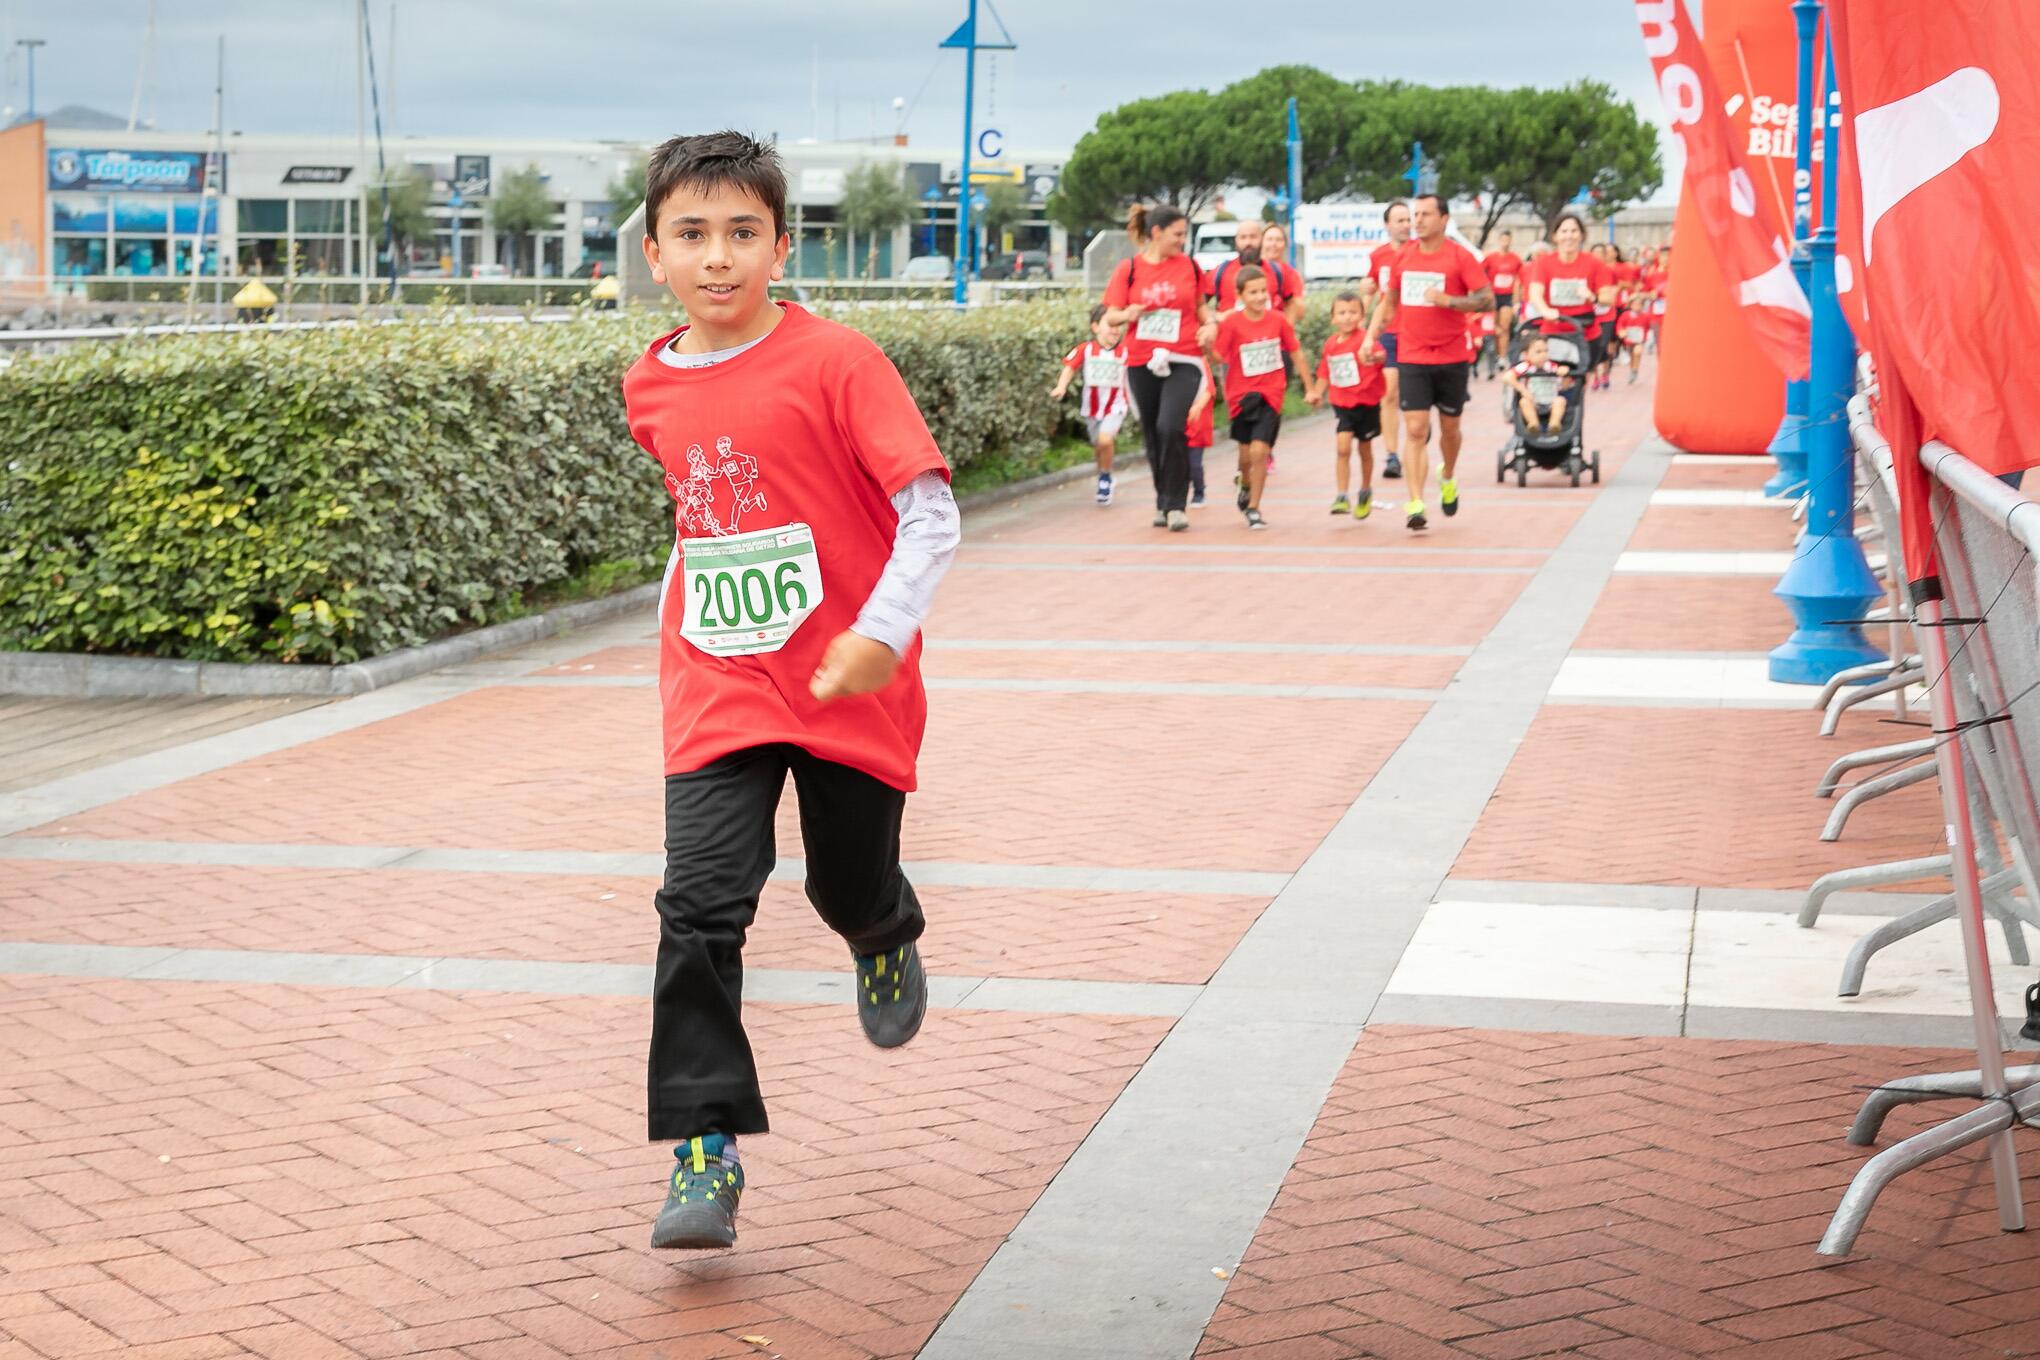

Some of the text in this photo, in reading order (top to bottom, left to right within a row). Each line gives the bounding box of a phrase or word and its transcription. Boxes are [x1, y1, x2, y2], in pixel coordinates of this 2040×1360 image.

[979, 129, 1003, 158] C
[86, 154, 191, 183] Tarpoon
[695, 561, 808, 628] 2006
